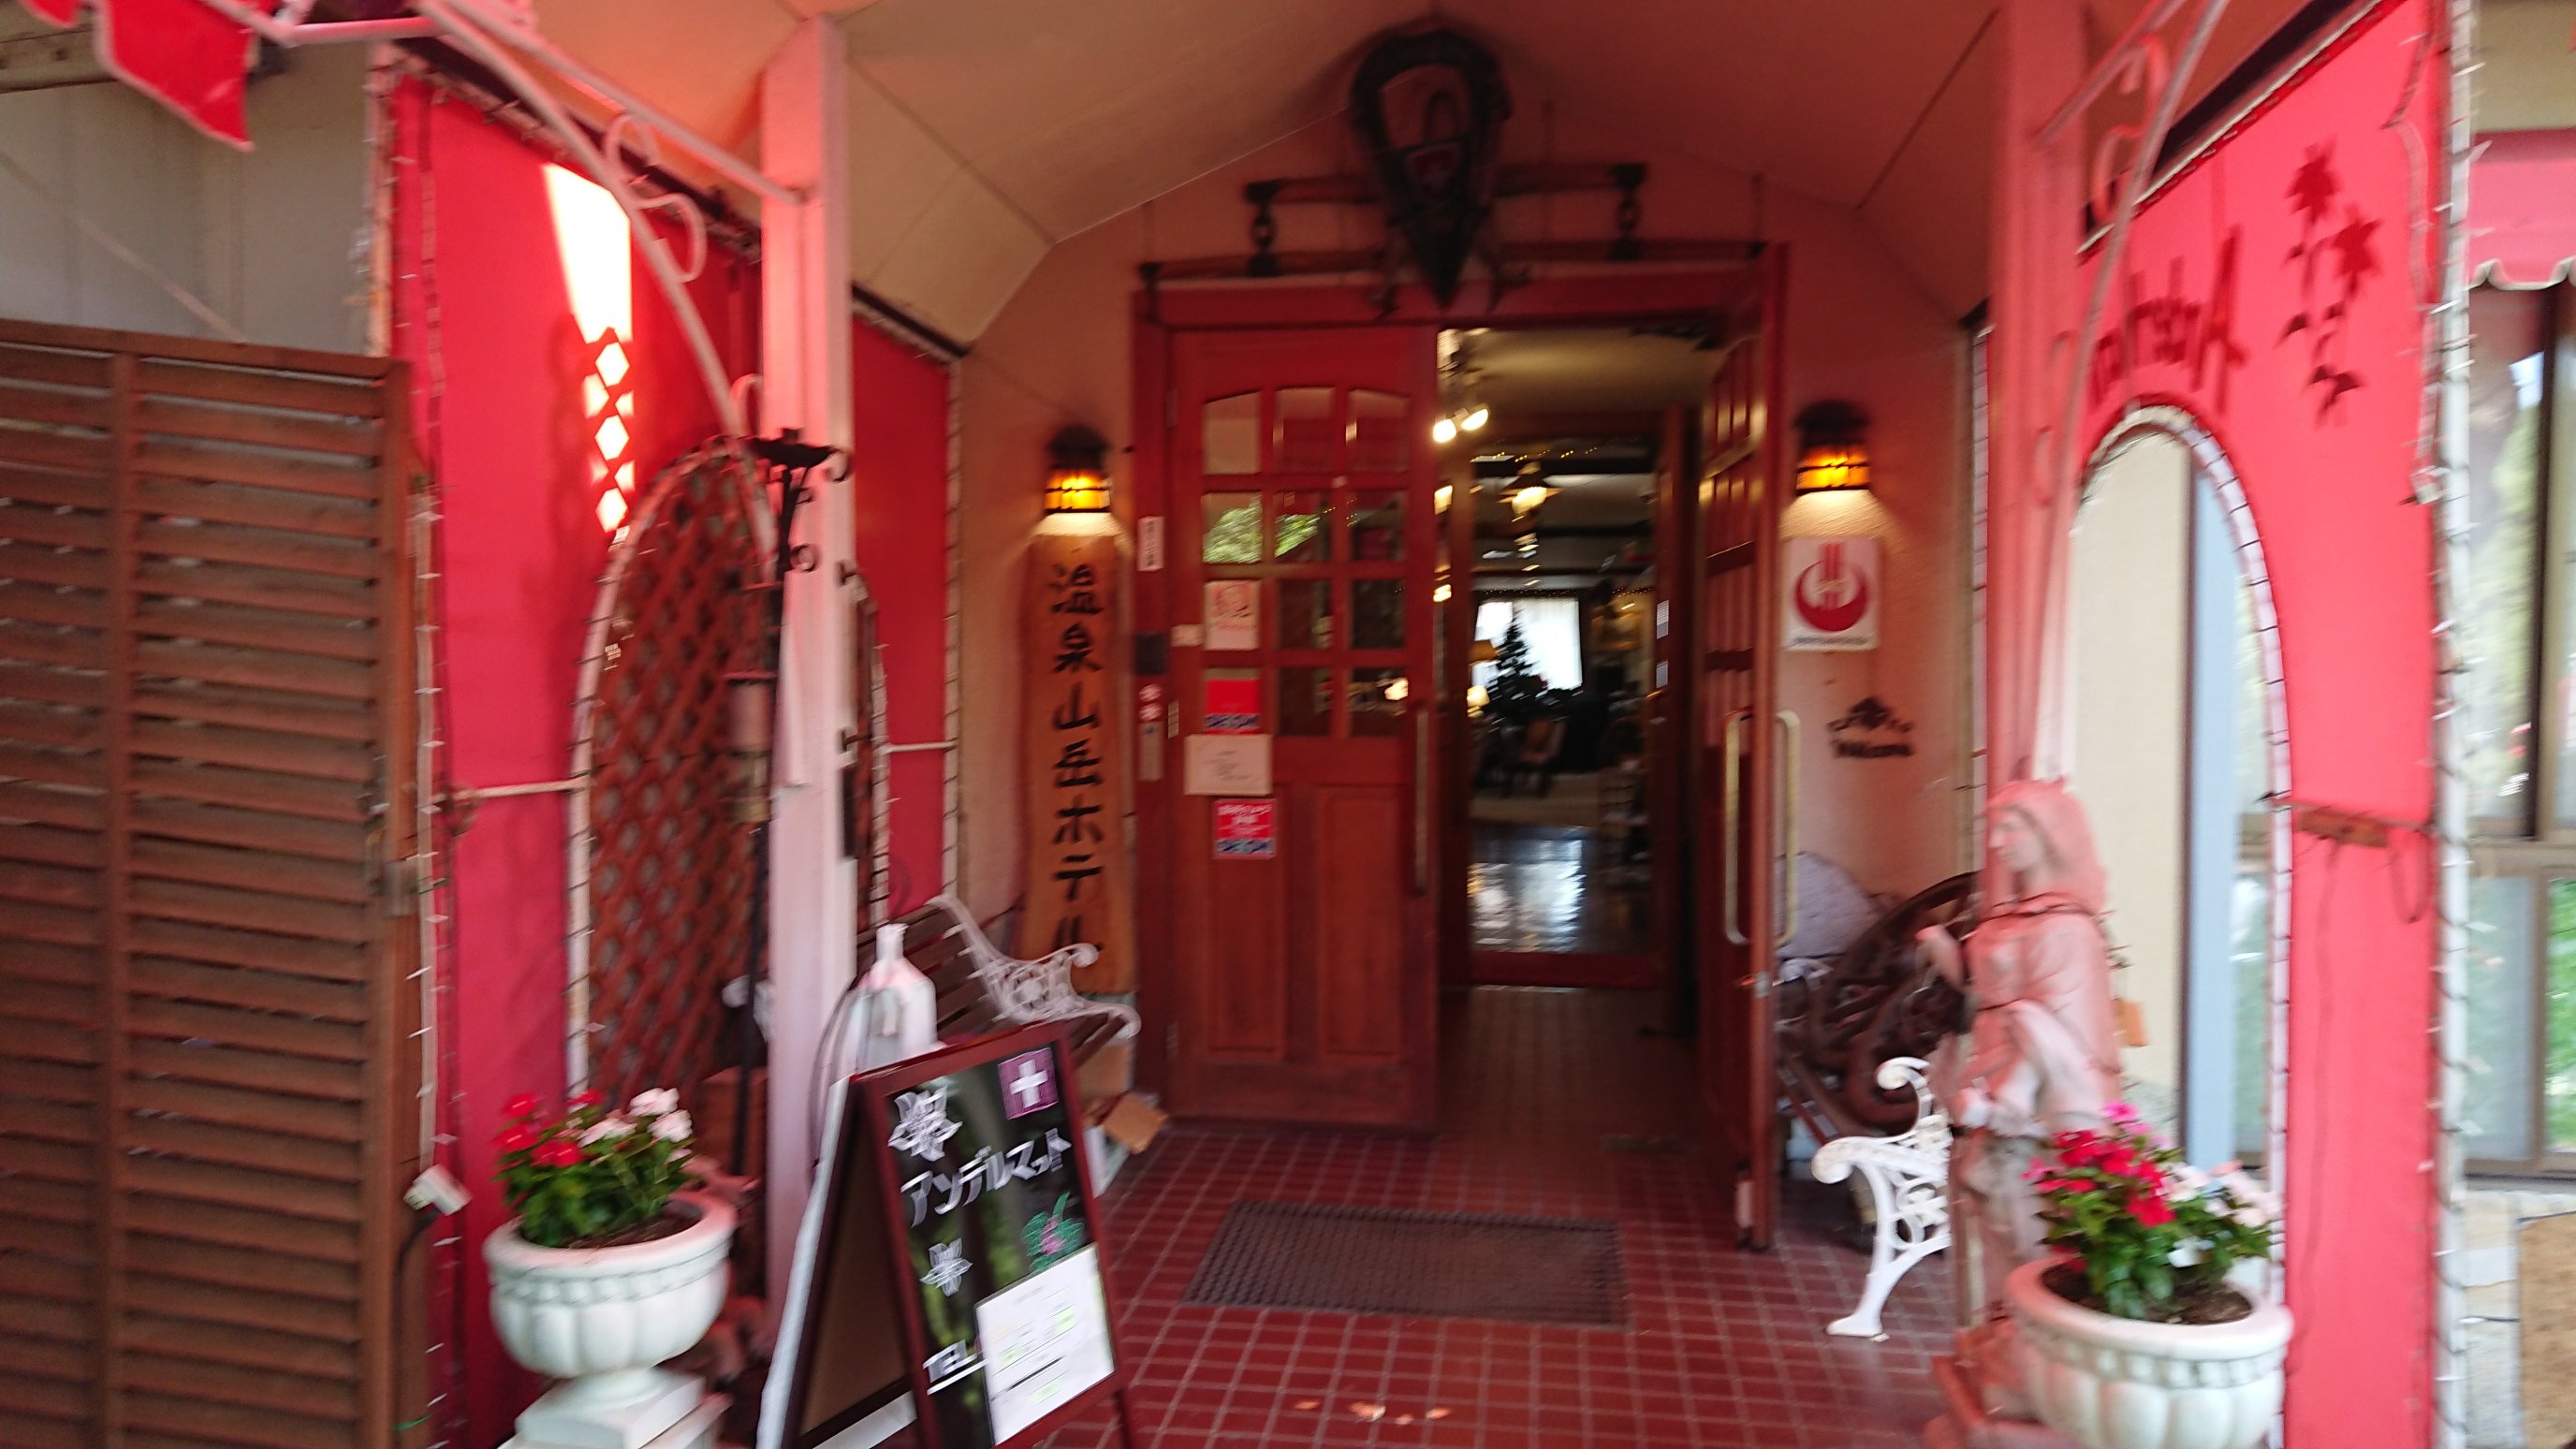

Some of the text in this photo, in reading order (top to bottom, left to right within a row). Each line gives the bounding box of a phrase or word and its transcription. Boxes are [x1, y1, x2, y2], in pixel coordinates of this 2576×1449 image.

[900, 1127, 1072, 1227] アンデルマット
[922, 1339, 978, 1383] TEL
